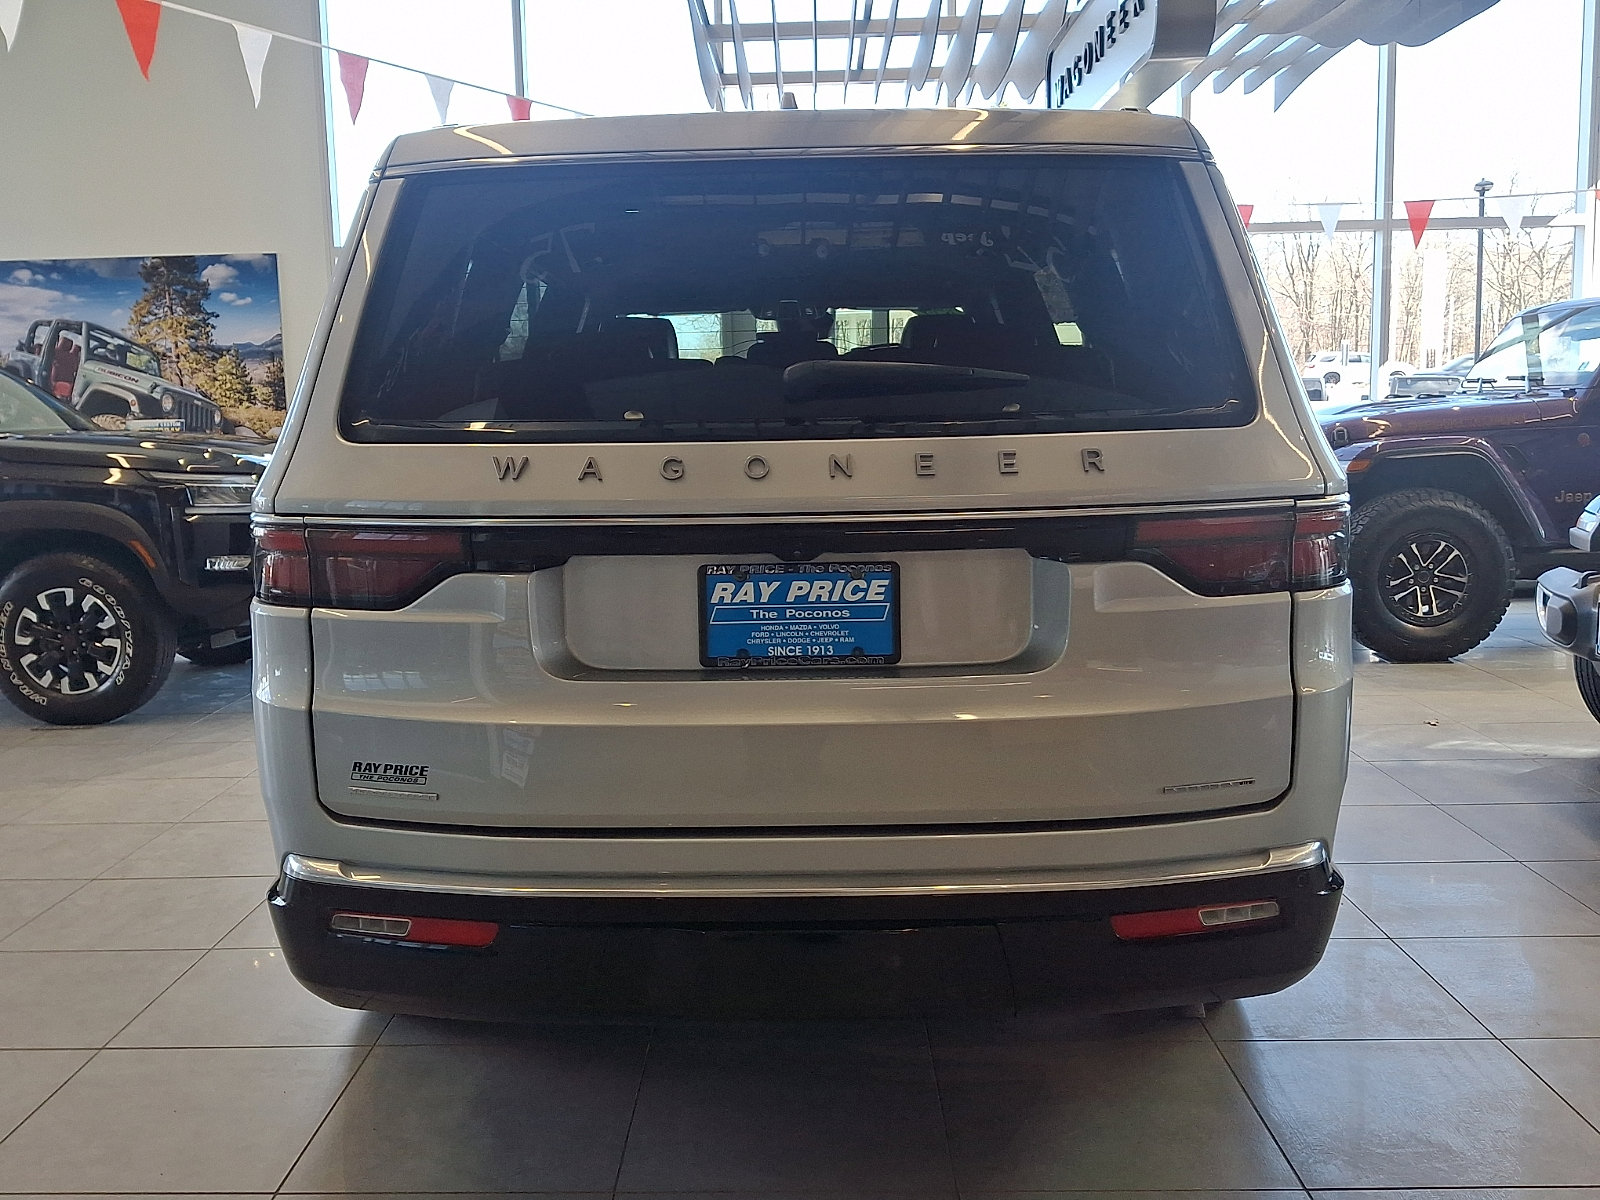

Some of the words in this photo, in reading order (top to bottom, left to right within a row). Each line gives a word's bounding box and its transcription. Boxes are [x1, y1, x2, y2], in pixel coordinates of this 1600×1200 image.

[491, 446, 1105, 483] WAGONEER
[706, 565, 735, 574] RAY
[739, 564, 785, 574] PRICE
[710, 580, 782, 604] RAY
[785, 579, 890, 603] PRICE
[749, 609, 779, 619] The
[785, 608, 851, 619] Poconos
[746, 637, 782, 645] CHRYSLER
[767, 645, 803, 656] SINCE
[806, 645, 834, 656] 1913
[352, 761, 383, 773] RAY
[382, 763, 430, 777] PRICE
